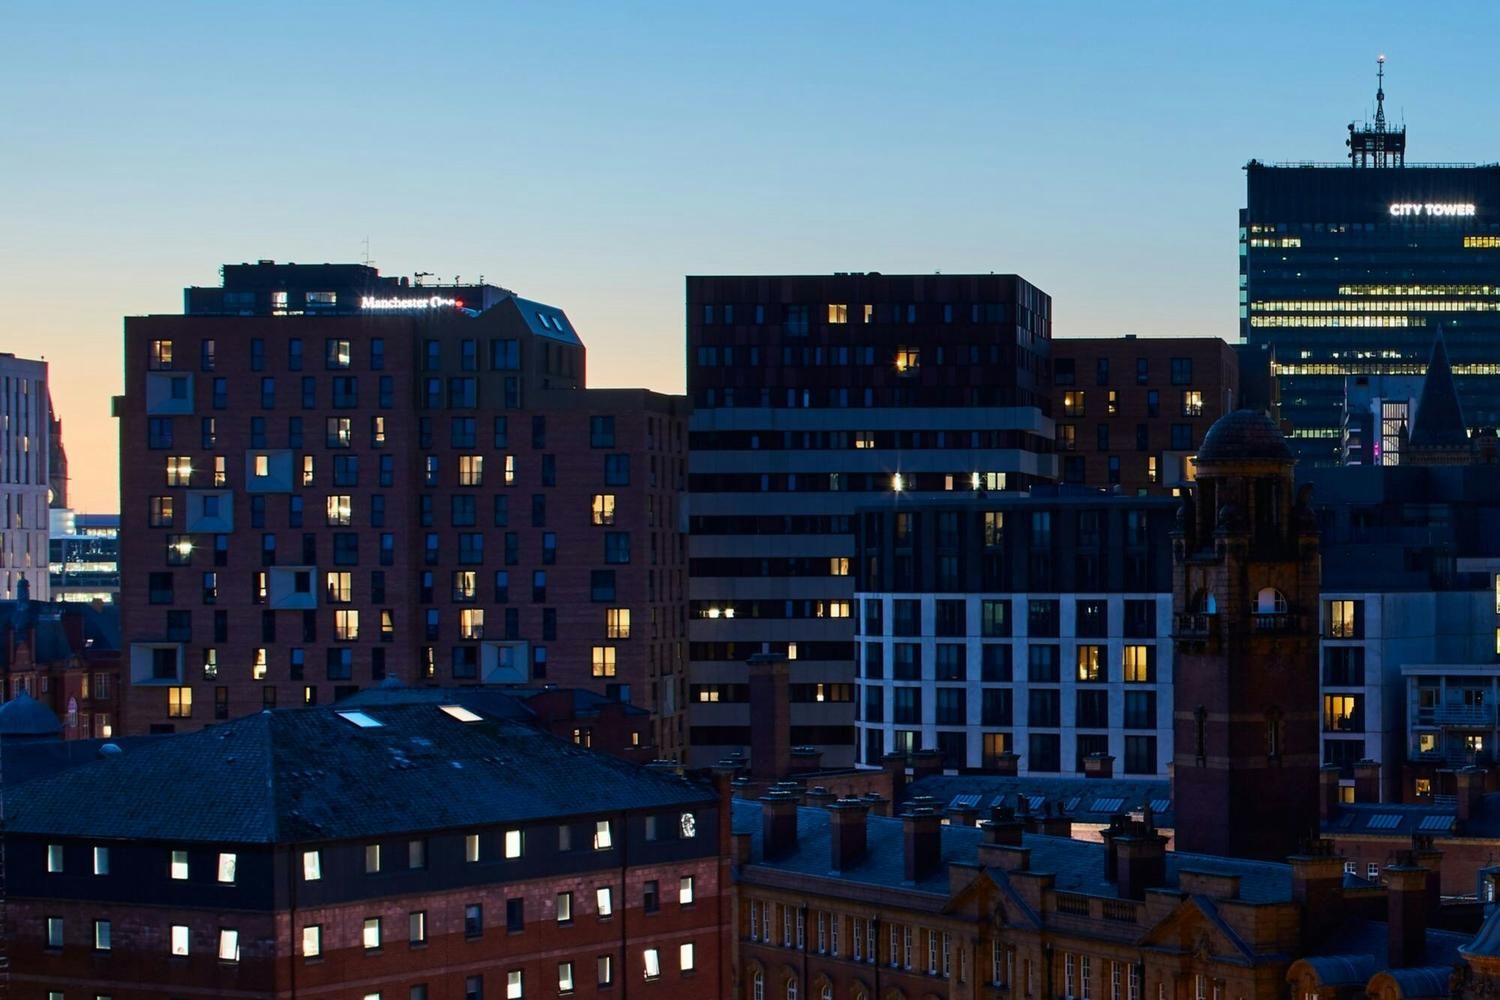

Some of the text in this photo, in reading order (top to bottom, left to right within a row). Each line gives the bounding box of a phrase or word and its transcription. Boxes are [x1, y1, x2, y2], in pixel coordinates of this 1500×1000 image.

[1389, 203, 1476, 216] CITY TOWER
[361, 296, 428, 309] Manchester
